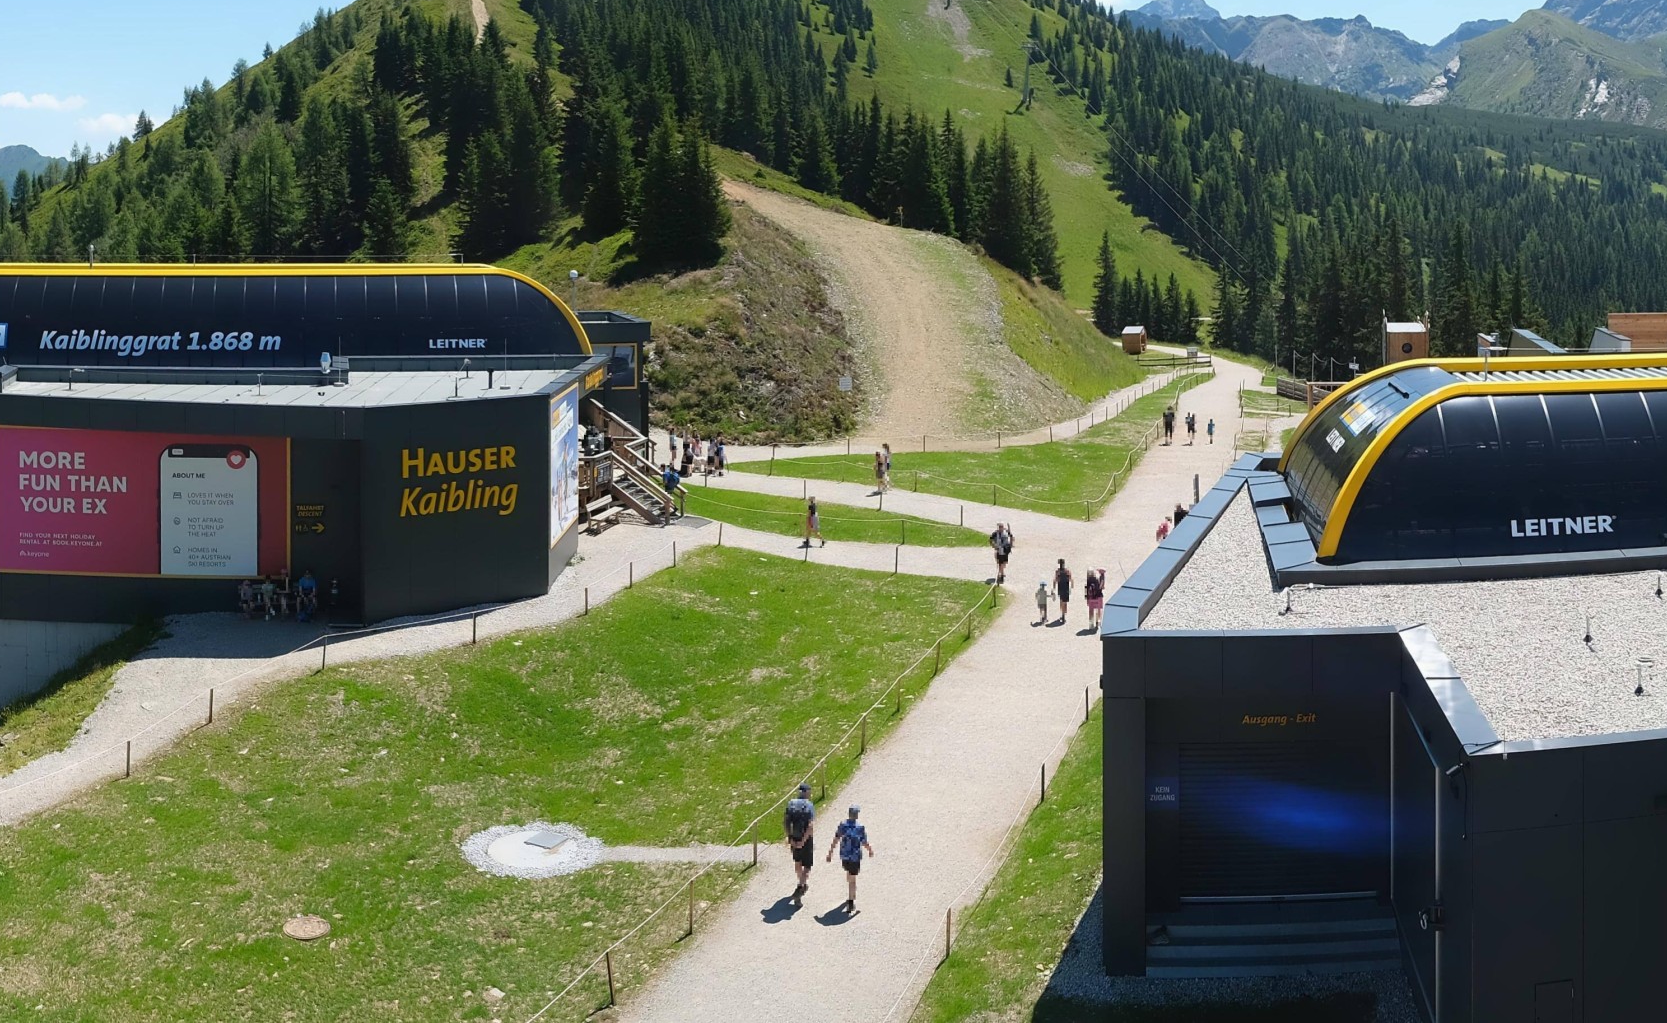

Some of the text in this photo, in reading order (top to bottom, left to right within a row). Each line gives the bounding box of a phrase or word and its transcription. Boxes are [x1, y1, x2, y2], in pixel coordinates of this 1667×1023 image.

[39, 329, 282, 357] Kaiblinggrat 1.868 m
[19, 450, 86, 469] MORE
[402, 445, 517, 479] HAUSER
[19, 474, 127, 493] FUN THAN
[20, 496, 108, 514] YOUR EX
[400, 479, 519, 517] Kaibling
[1242, 713, 1288, 727] Ausgang
[1296, 712, 1317, 724] Exit
[1149, 793, 1176, 802] ZUGANG
[1155, 785, 1170, 794] KEIN
